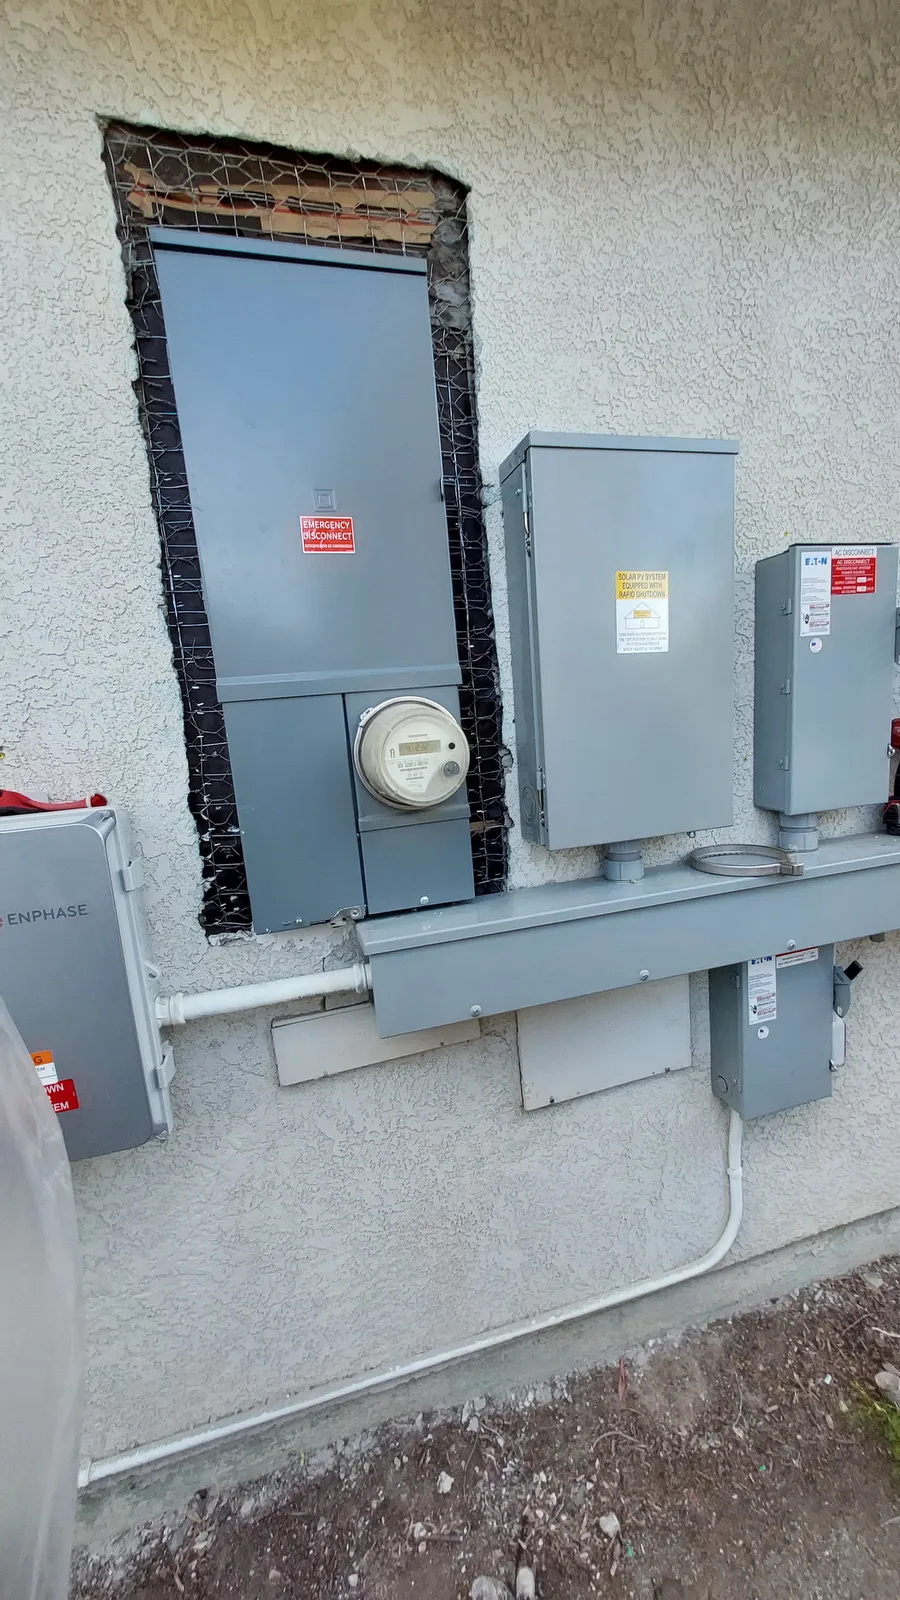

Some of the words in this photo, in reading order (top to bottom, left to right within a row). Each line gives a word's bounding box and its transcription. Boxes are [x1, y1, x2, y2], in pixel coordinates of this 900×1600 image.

[303, 521, 350, 529] EMERGENCY
[303, 532, 351, 540] DISCONNECT
[835, 548, 842, 556] AC
[843, 548, 874, 556] DISCONNECT
[618, 573, 636, 581] SOLAR
[637, 573, 644, 581] PV
[645, 573, 666, 581] SYSTEM
[622, 582, 649, 590] EQUIPPED
[618, 590, 635, 598] RAPID
[636, 590, 666, 598] SHUTDOWN
[7, 904, 88, 925] ENPHASE
